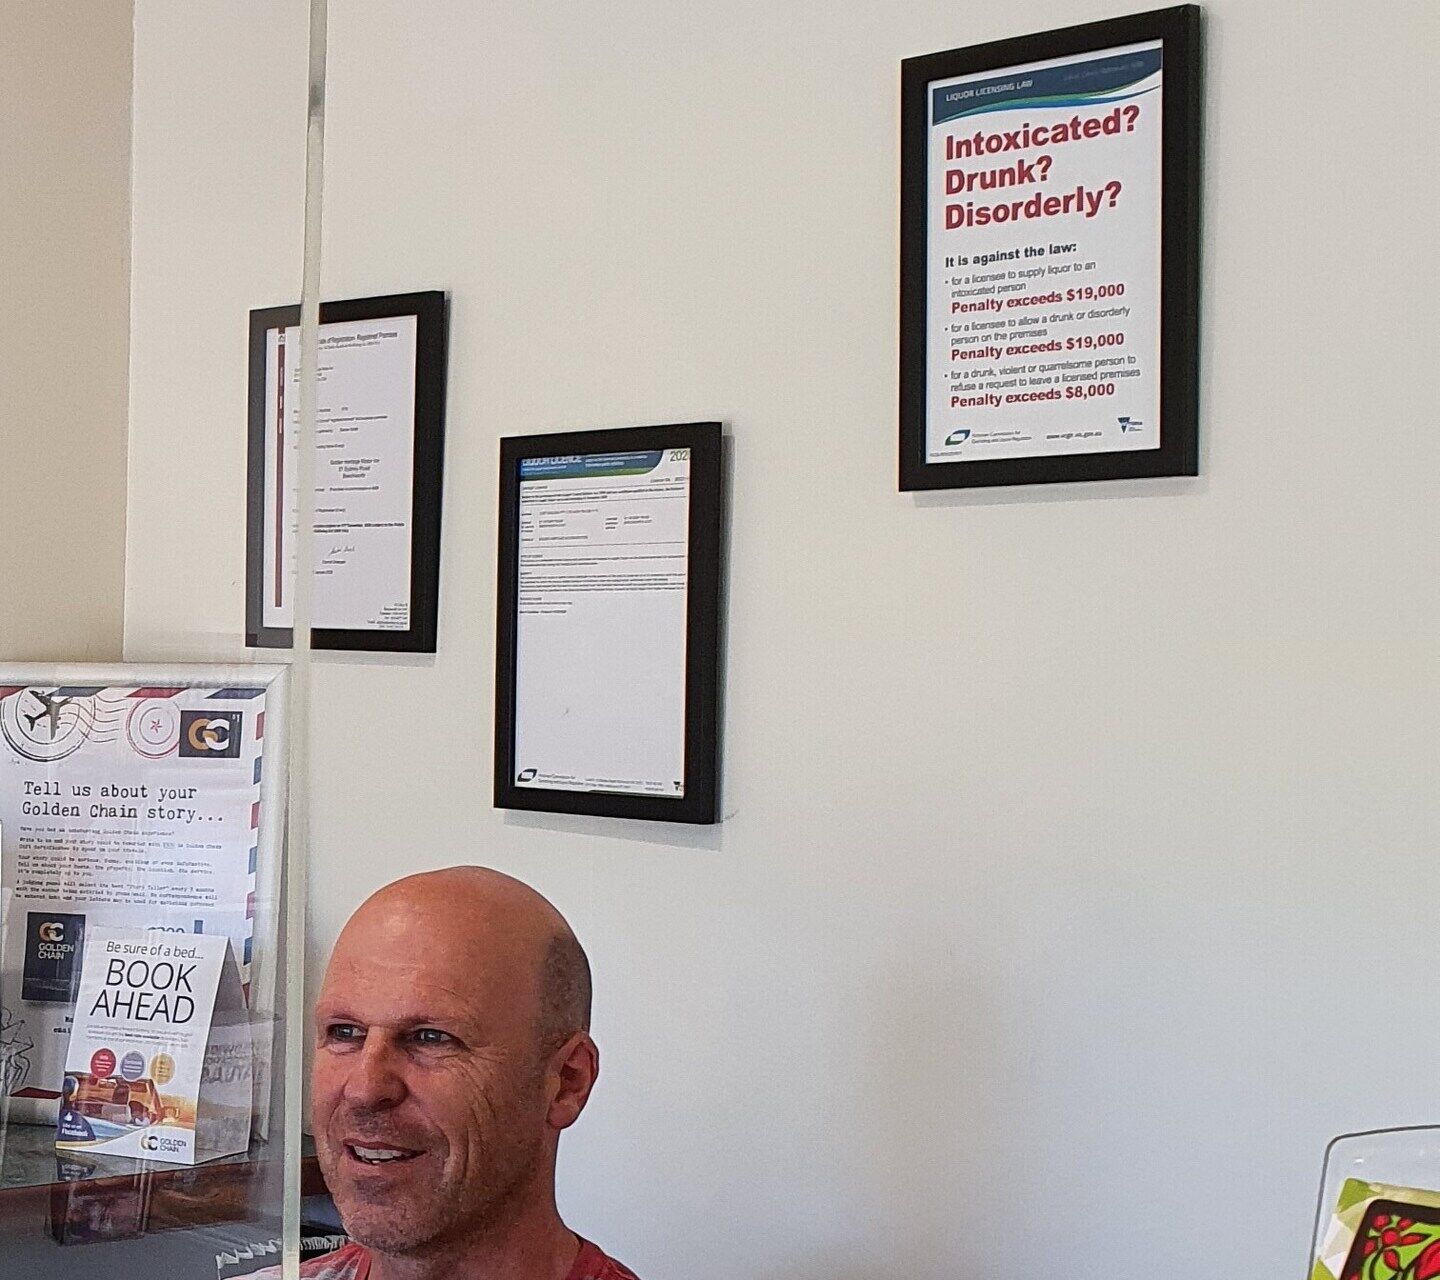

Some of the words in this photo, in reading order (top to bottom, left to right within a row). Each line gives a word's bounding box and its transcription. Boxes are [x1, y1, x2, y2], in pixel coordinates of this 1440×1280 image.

[946, 89, 974, 102] LIQUOR
[975, 82, 1015, 97] LICENSING
[946, 104, 1140, 161] Intoxicated?
[945, 155, 1053, 195] Drunk?
[945, 181, 1122, 230] Disorderly?
[945, 257, 954, 268] It
[958, 256, 968, 266] is
[973, 249, 1020, 266] against
[1024, 247, 1045, 257] the
[1049, 242, 1077, 255] law:
[1019, 266, 1046, 280] supply
[1074, 263, 1082, 272] to
[1085, 261, 1096, 270] an
[951, 298, 1004, 314] Penalty
[1007, 291, 1063, 308] exceeds
[1066, 283, 1125, 302] $19,000
[998, 283, 1026, 294] person
[1050, 313, 1074, 323] drunk
[1076, 312, 1086, 320] or
[1088, 305, 1131, 319] disorderly
[951, 344, 1002, 361] Penalty
[1006, 338, 1062, 356] exceeds
[1066, 332, 1125, 351] $19,000
[981, 334, 992, 342] on
[1027, 365, 1037, 373] or
[1094, 358, 1125, 369] person
[1127, 355, 1136, 365] to
[1018, 378, 1027, 386] to
[1029, 375, 1051, 386] leave
[1100, 368, 1141, 380] premises
[951, 393, 1002, 408] Penalty
[1006, 388, 1061, 403] exceeds
[1065, 383, 1115, 399] $8,000
[24, 781, 62, 796] Tell
[72, 785, 91, 796] us
[101, 784, 149, 798] about
[158, 786, 197, 802] your
[22, 802, 80, 817] Golden
[90, 804, 138, 818] Chain
[147, 806, 223, 823] story...
[38, 943, 74, 952] GOLDEN
[38, 952, 64, 960] CHAIN
[106, 941, 120, 953] Be
[123, 944, 147, 954] sure
[150, 943, 162, 955] of
[163, 948, 171, 956] a
[174, 948, 204, 959] bed...
[106, 959, 197, 993] BOOK
[90, 989, 195, 1024] AHEAD
[160, 1138, 186, 1147] GOLDEN
[160, 1145, 180, 1153] CHAIN
